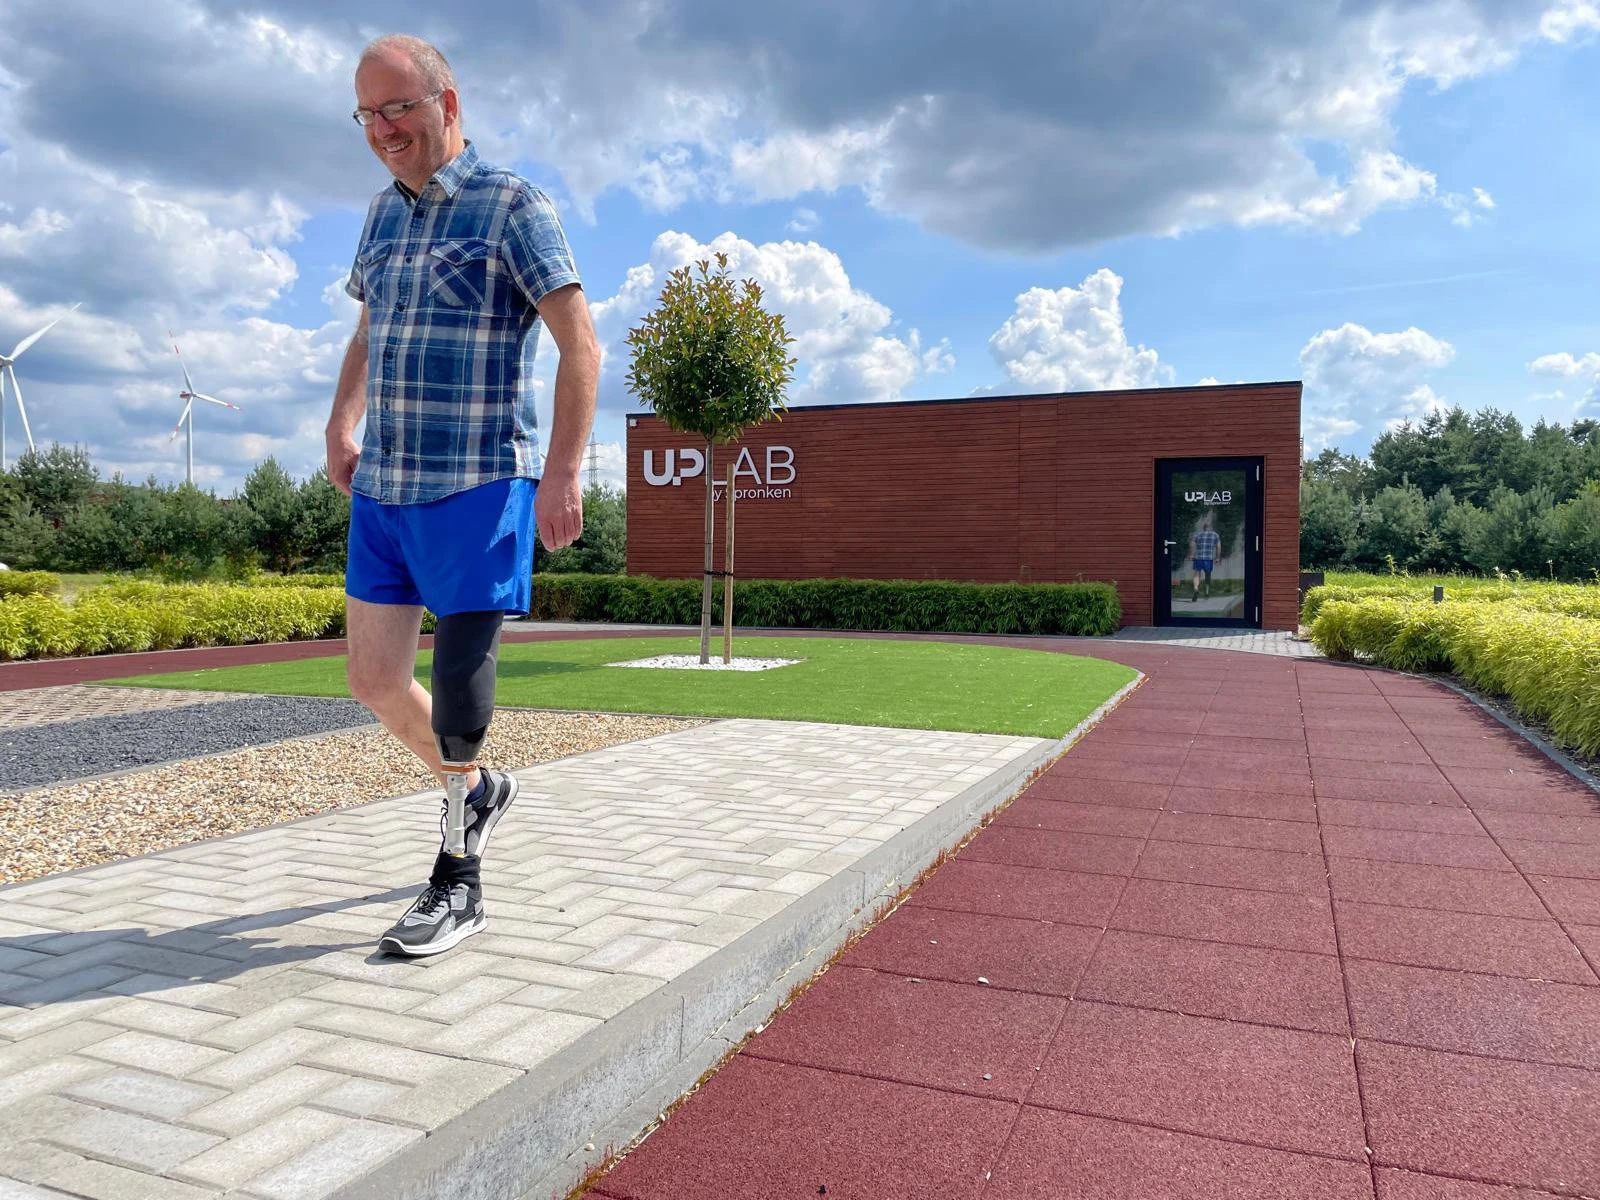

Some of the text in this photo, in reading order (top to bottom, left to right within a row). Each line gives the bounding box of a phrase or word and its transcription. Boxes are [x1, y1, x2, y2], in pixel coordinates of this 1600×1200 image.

[643, 446, 797, 486] UPLAB
[726, 485, 792, 501] pronken
[1184, 490, 1232, 502] UPLAB
